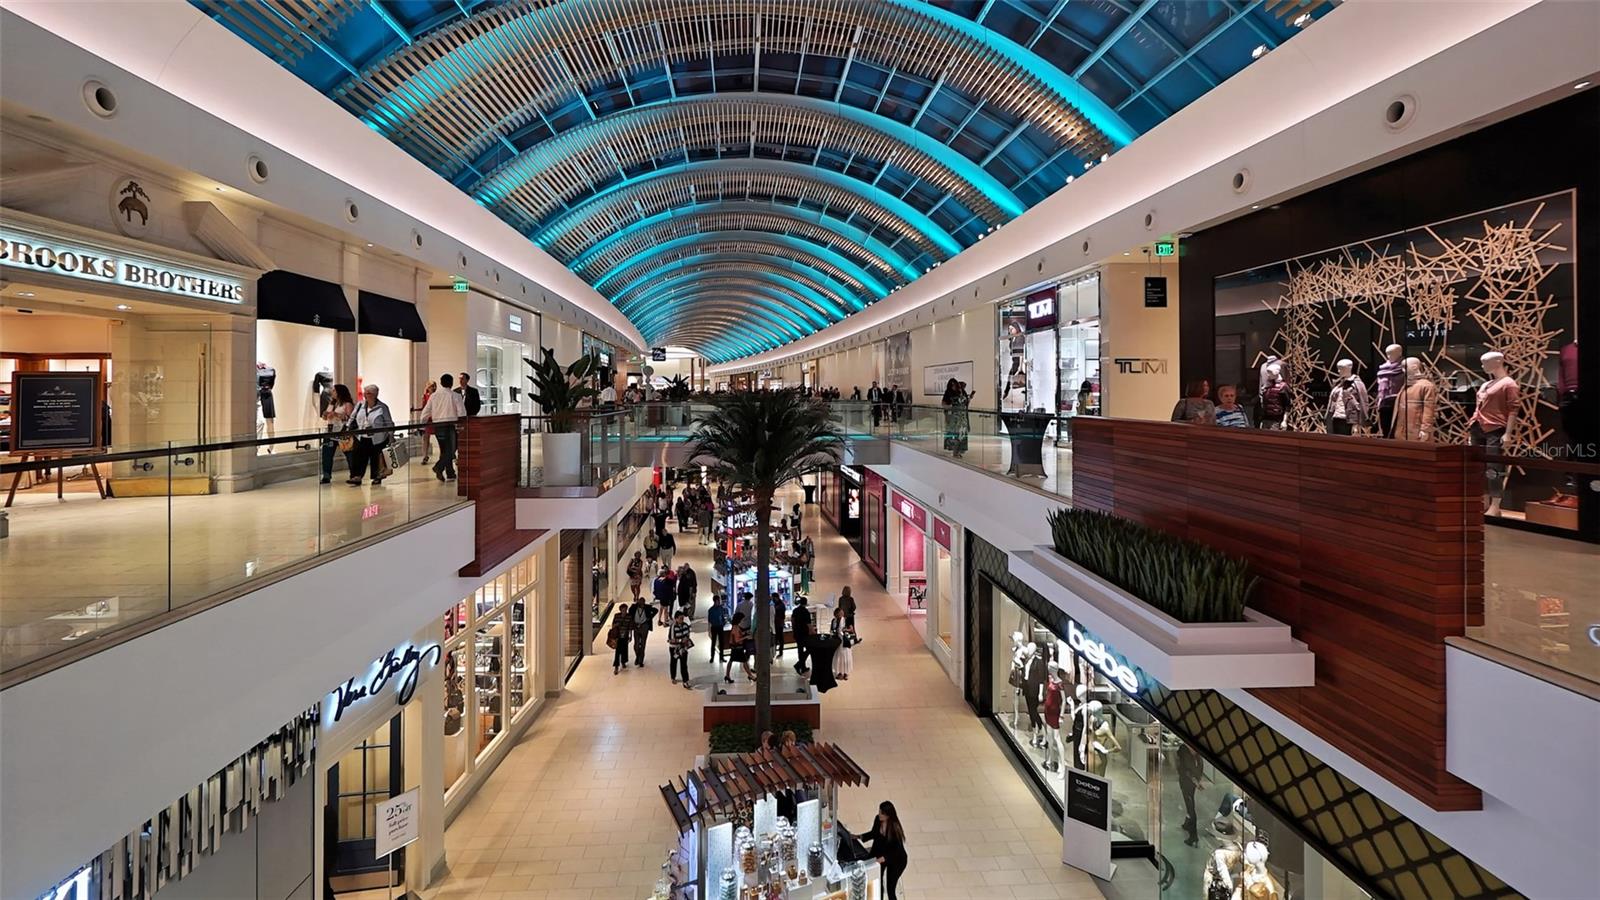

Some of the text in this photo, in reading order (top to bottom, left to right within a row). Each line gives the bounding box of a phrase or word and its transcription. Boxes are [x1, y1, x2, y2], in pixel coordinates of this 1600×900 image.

[0, 237, 244, 301] BROOKS BROTHERS
[1115, 358, 1168, 374] TUMI
[1068, 620, 1138, 693] bebe
[332, 676, 368, 721] Vera
[1076, 779, 1101, 792] bebe
